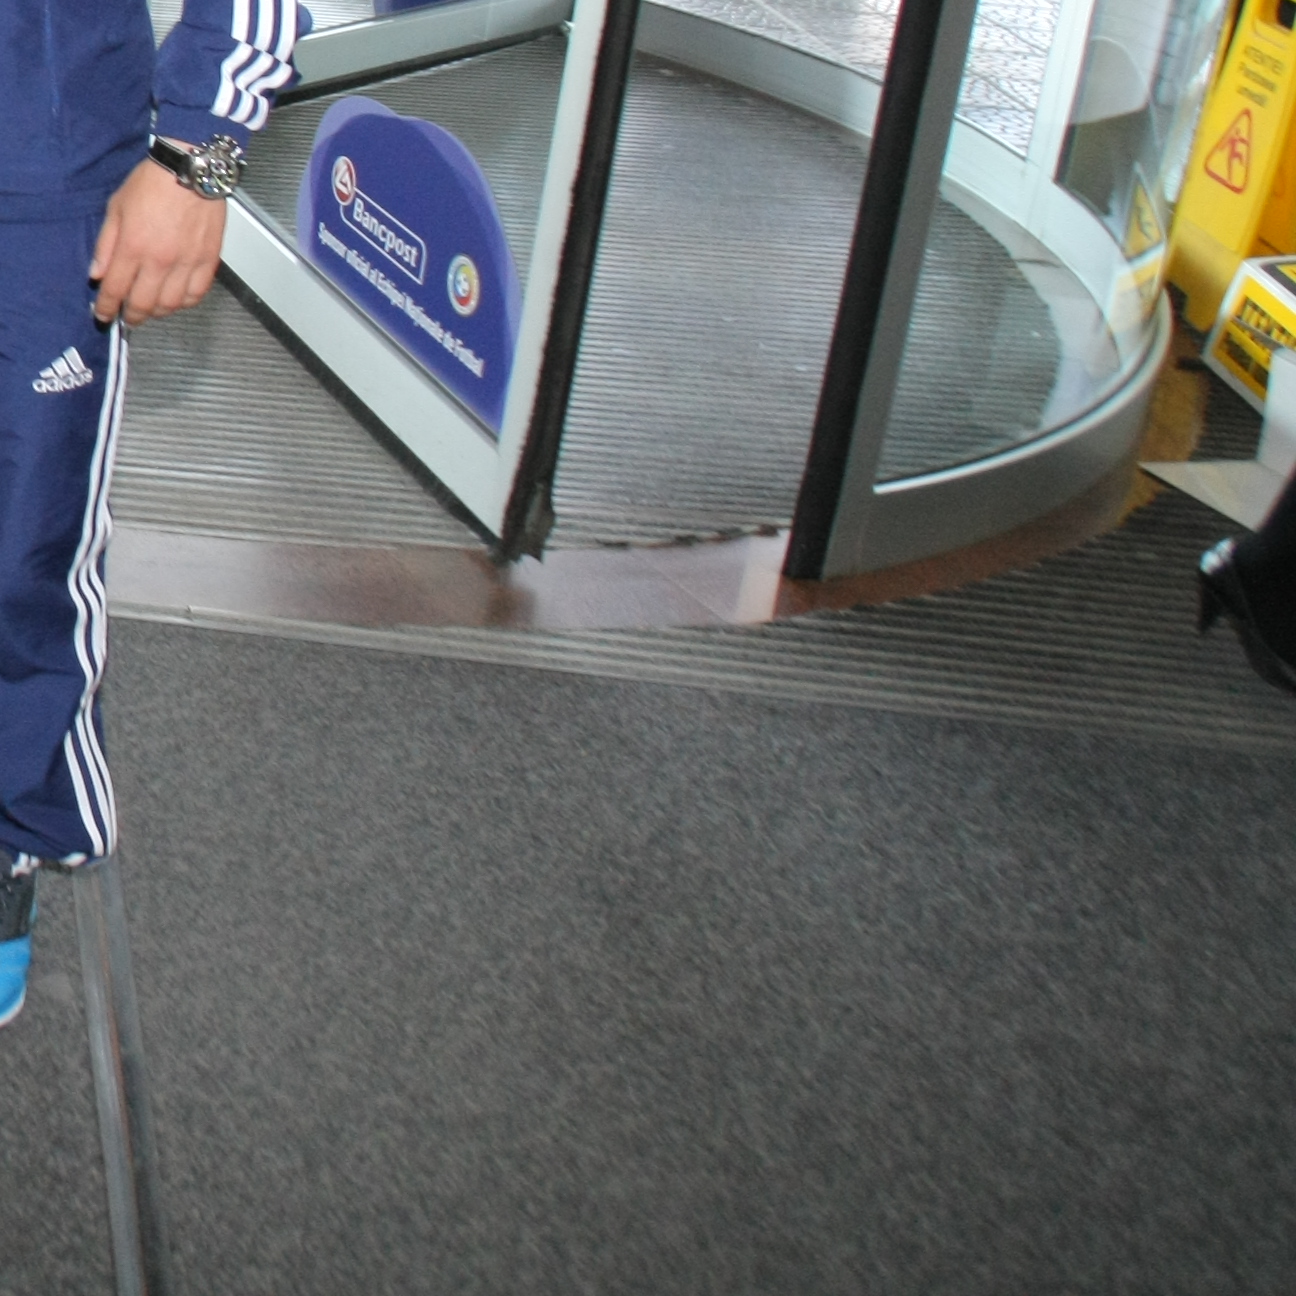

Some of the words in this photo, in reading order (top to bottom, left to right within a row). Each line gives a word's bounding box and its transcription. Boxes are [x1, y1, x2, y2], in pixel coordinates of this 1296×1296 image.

[318, 221, 347, 258] Sponsor
[353, 197, 419, 268] Bancpost
[32, 368, 94, 393] adidas
